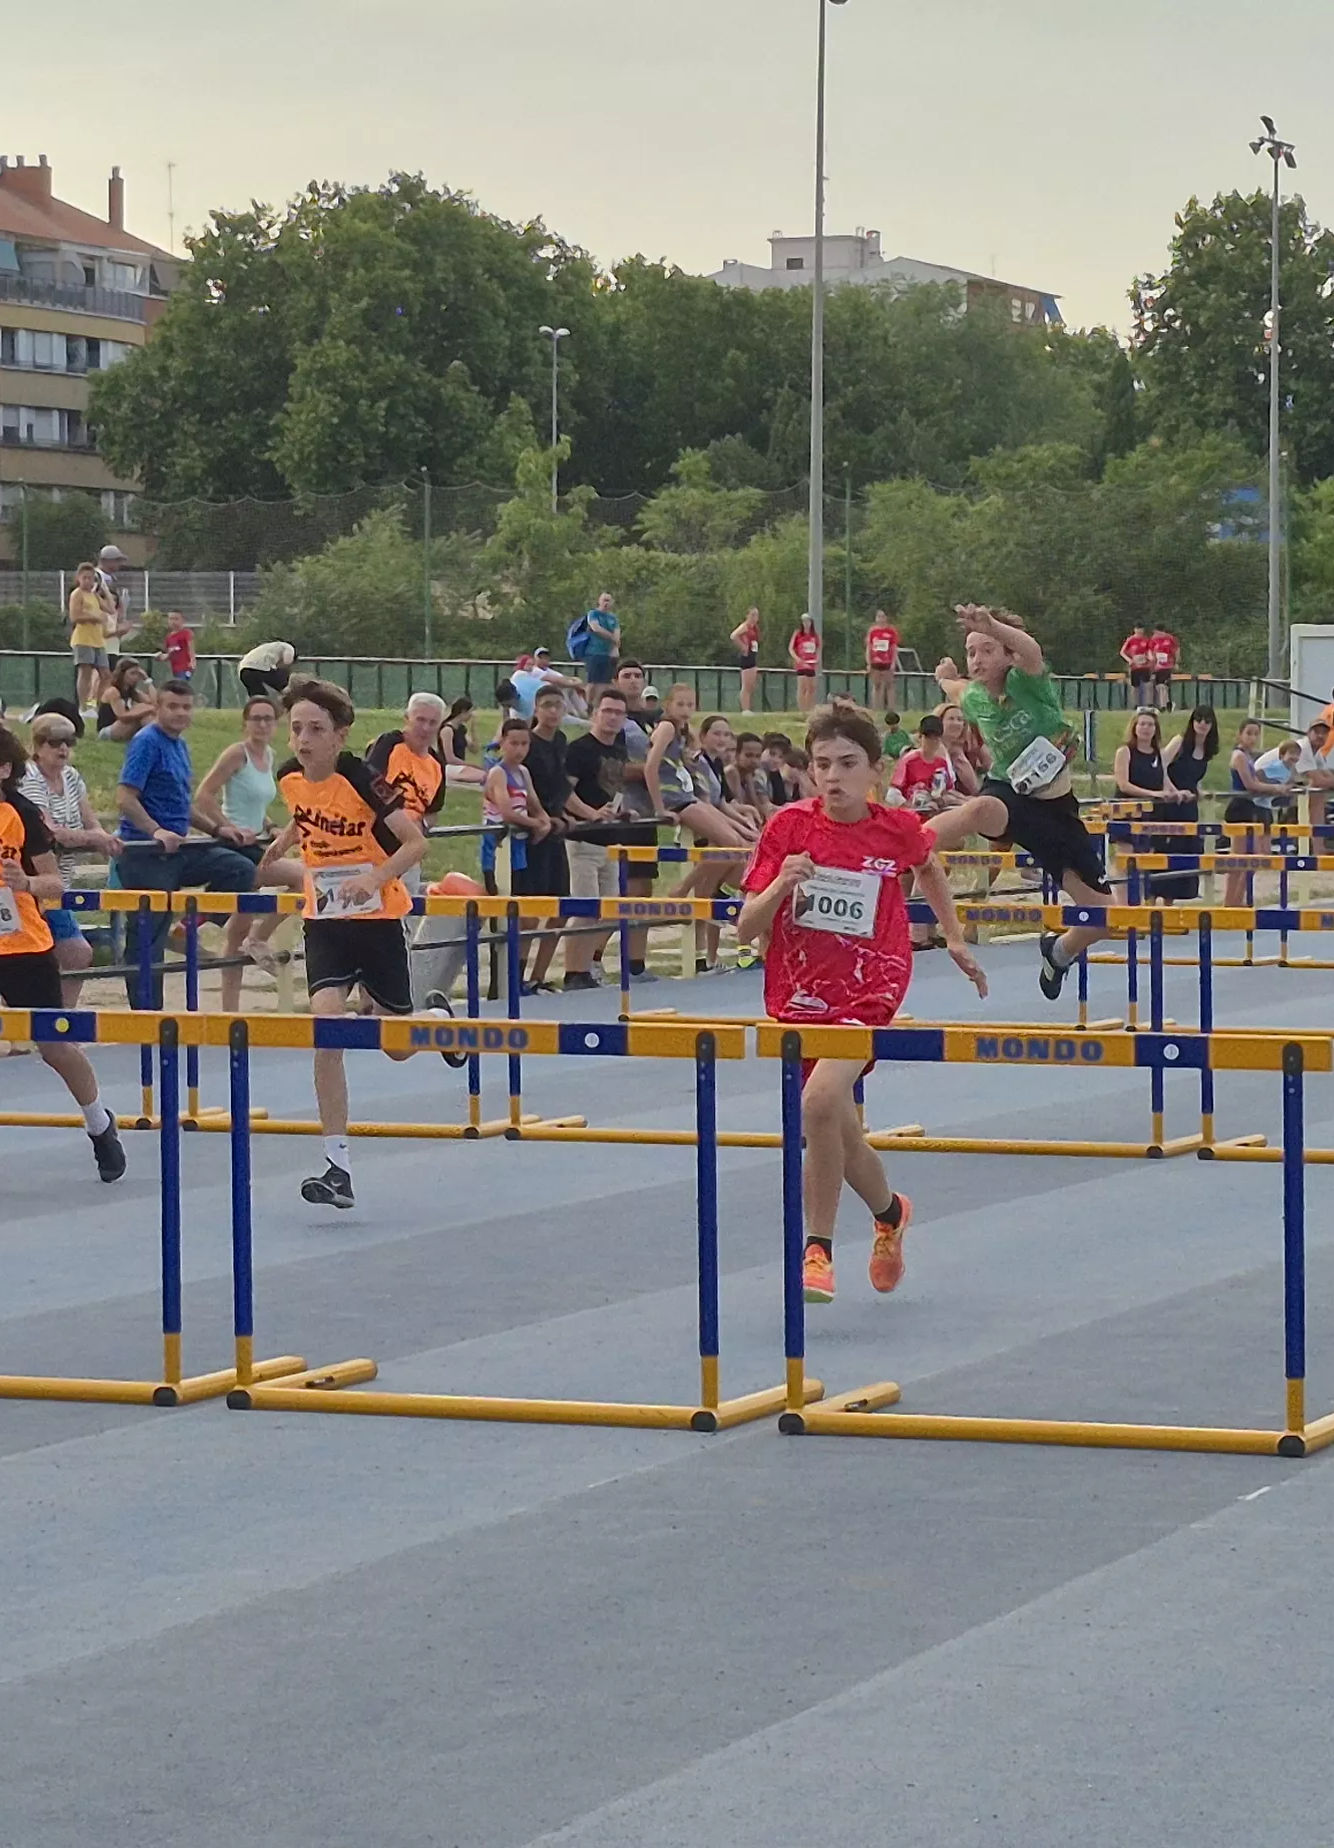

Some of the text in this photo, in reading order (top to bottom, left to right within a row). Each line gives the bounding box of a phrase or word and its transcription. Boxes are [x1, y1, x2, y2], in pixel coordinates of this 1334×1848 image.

[619, 902, 692, 915] MONDO
[807, 894, 864, 919] 1006
[966, 908, 1042, 922] MONDO
[410, 1026, 528, 1049] MONDO
[976, 1037, 1104, 1062] MONDO
